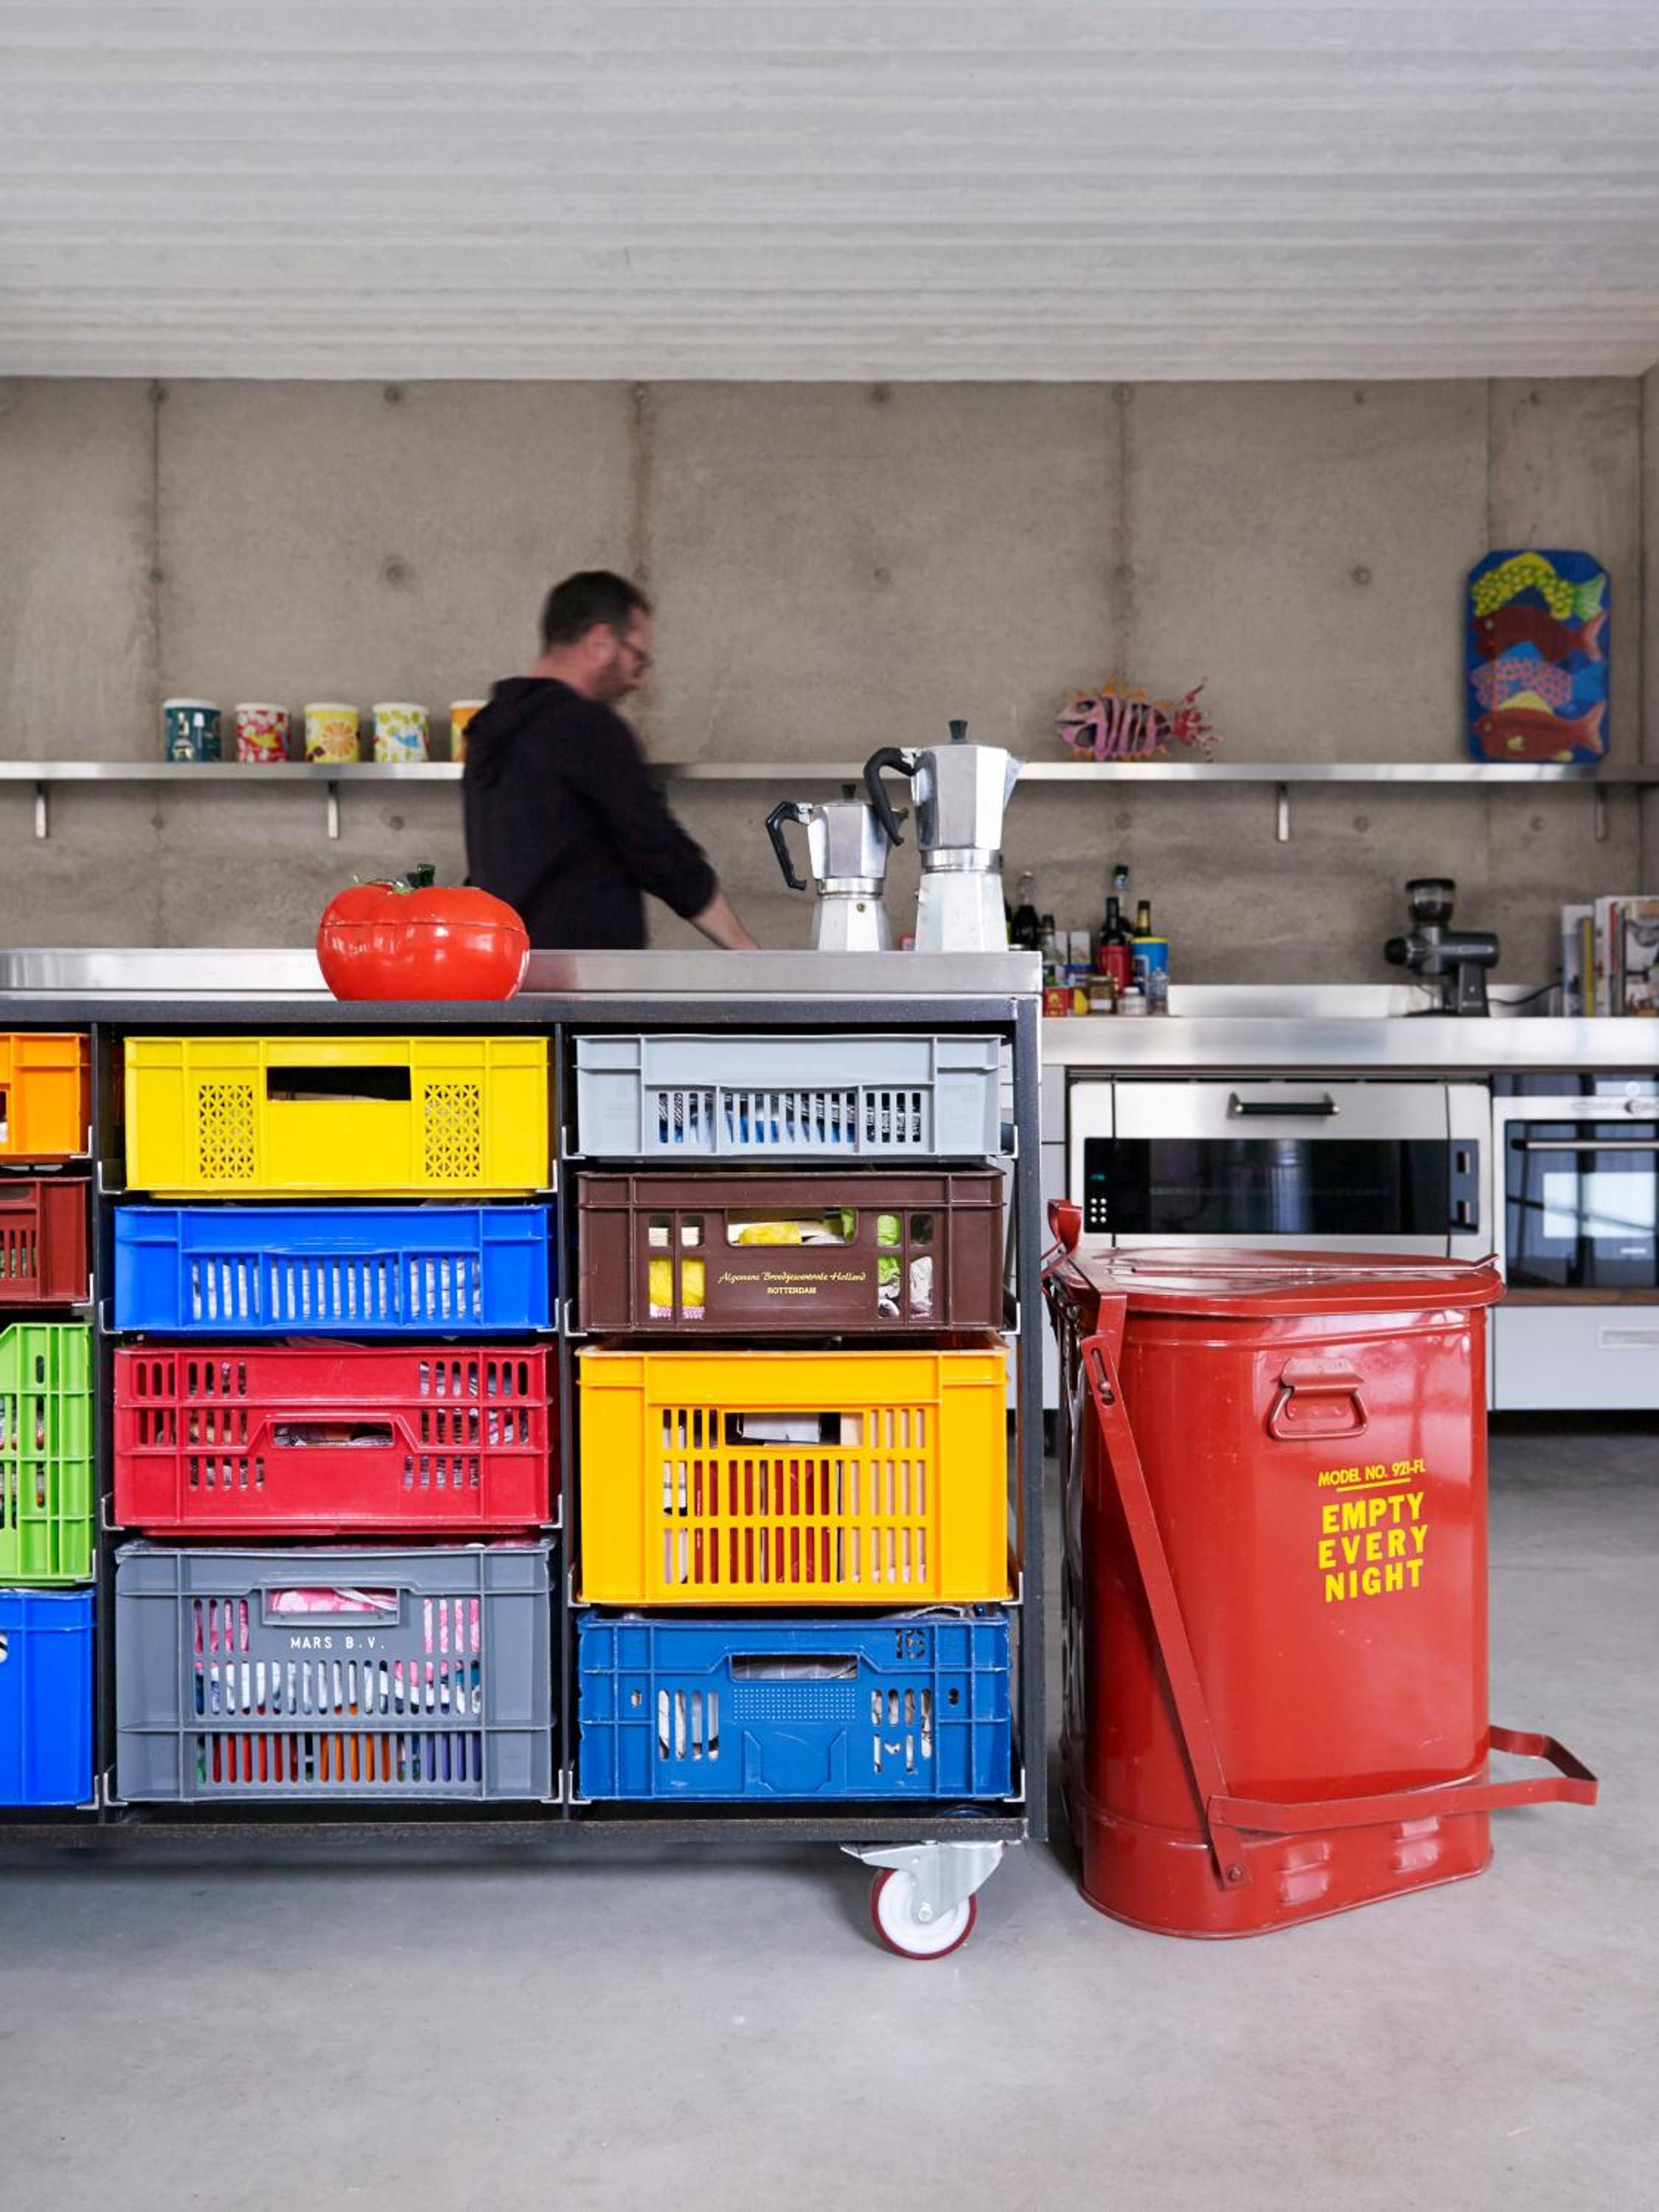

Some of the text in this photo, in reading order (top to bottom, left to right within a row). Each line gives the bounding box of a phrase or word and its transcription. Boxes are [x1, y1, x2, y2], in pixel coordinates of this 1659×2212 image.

[830, 1272, 866, 1281] Holland
[1318, 1469, 1361, 1486] MODEL
[1365, 1464, 1388, 1481] NO.
[1322, 1492, 1424, 1534] EMPTY
[1318, 1524, 1428, 1569] EVERY
[1325, 1558, 1424, 1602] NIGHT
[291, 1636, 332, 1649] MARS
